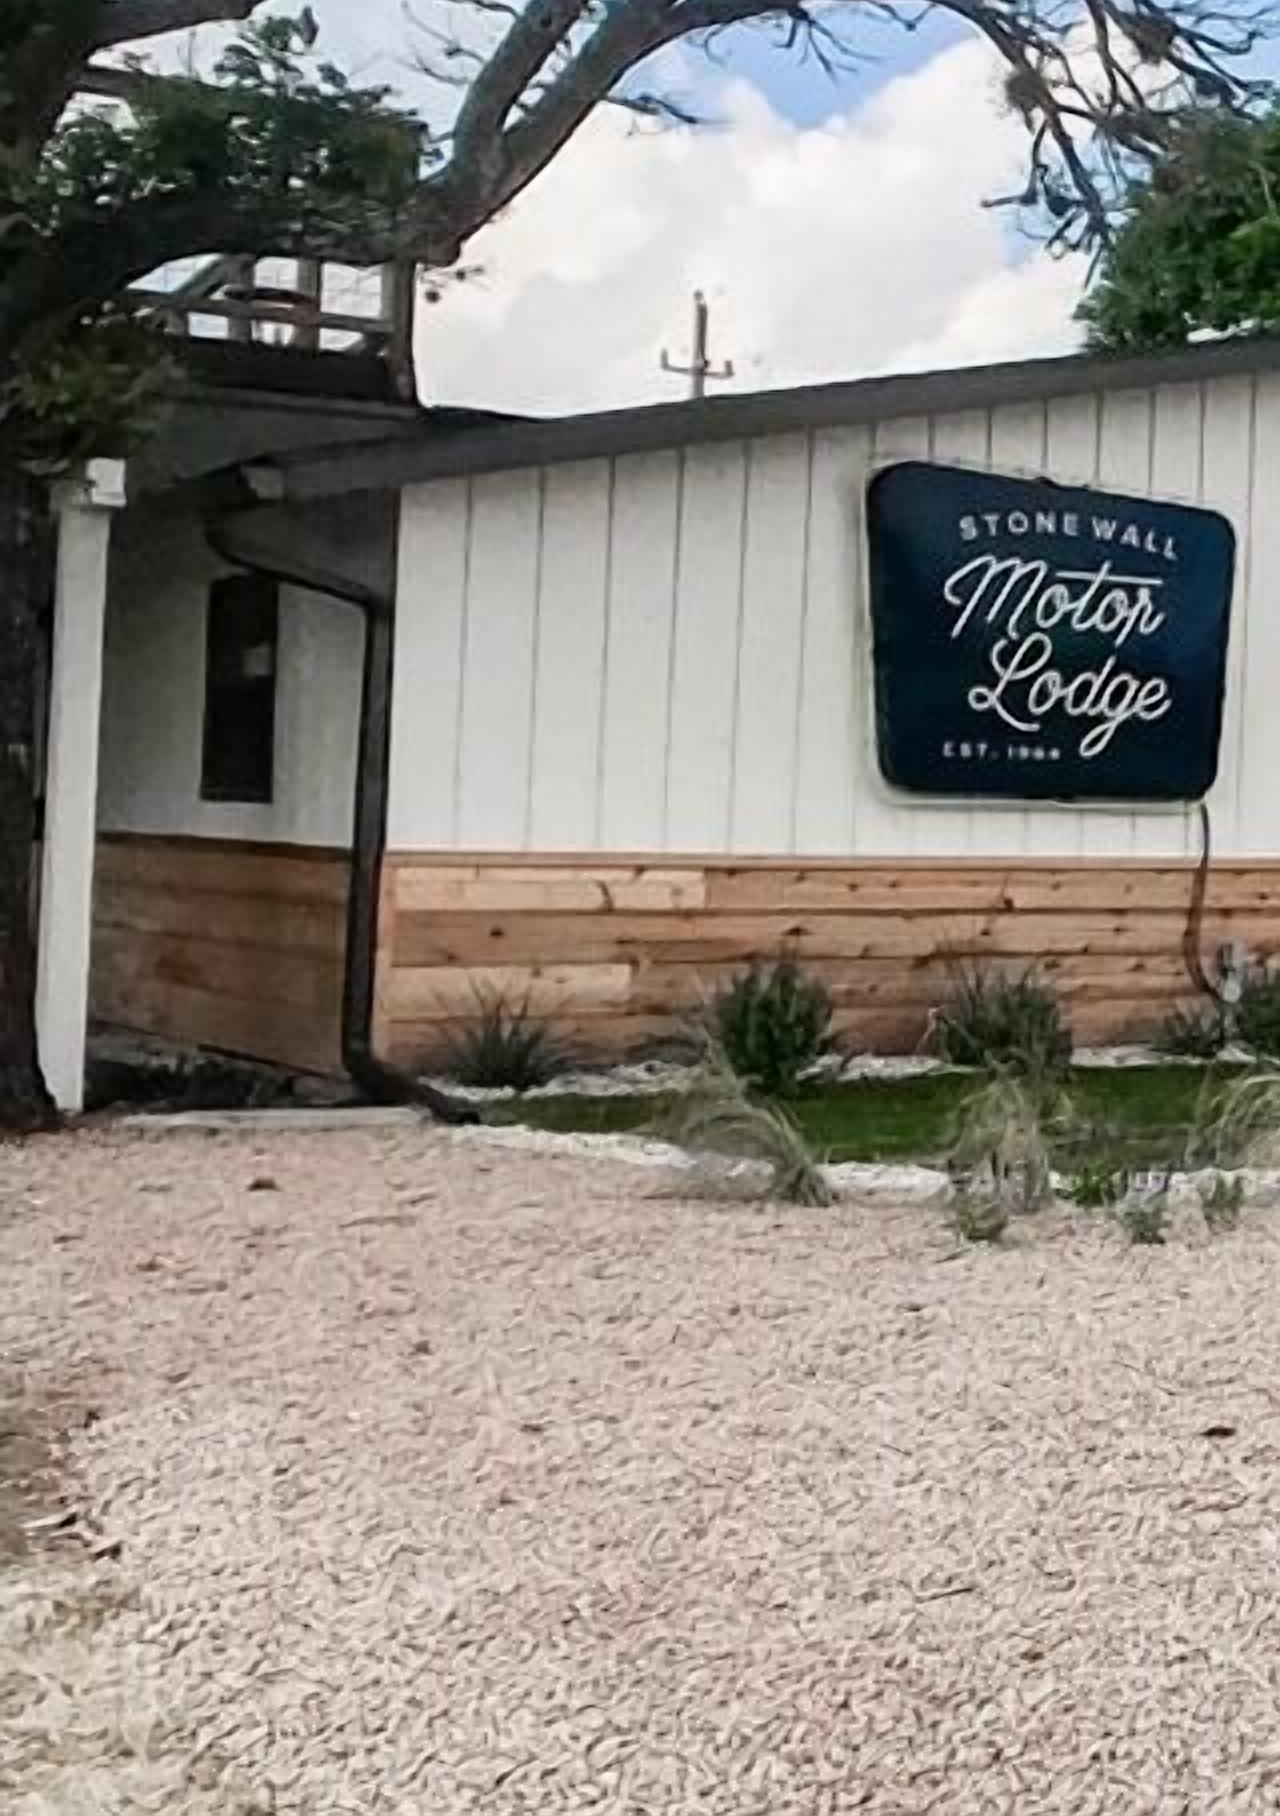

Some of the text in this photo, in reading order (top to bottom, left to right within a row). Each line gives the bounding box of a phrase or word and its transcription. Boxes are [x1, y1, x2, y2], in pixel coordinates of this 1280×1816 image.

[958, 510, 1178, 561] STONE WALL
[943, 554, 1166, 647] Motor
[967, 631, 1173, 758] Lodge
